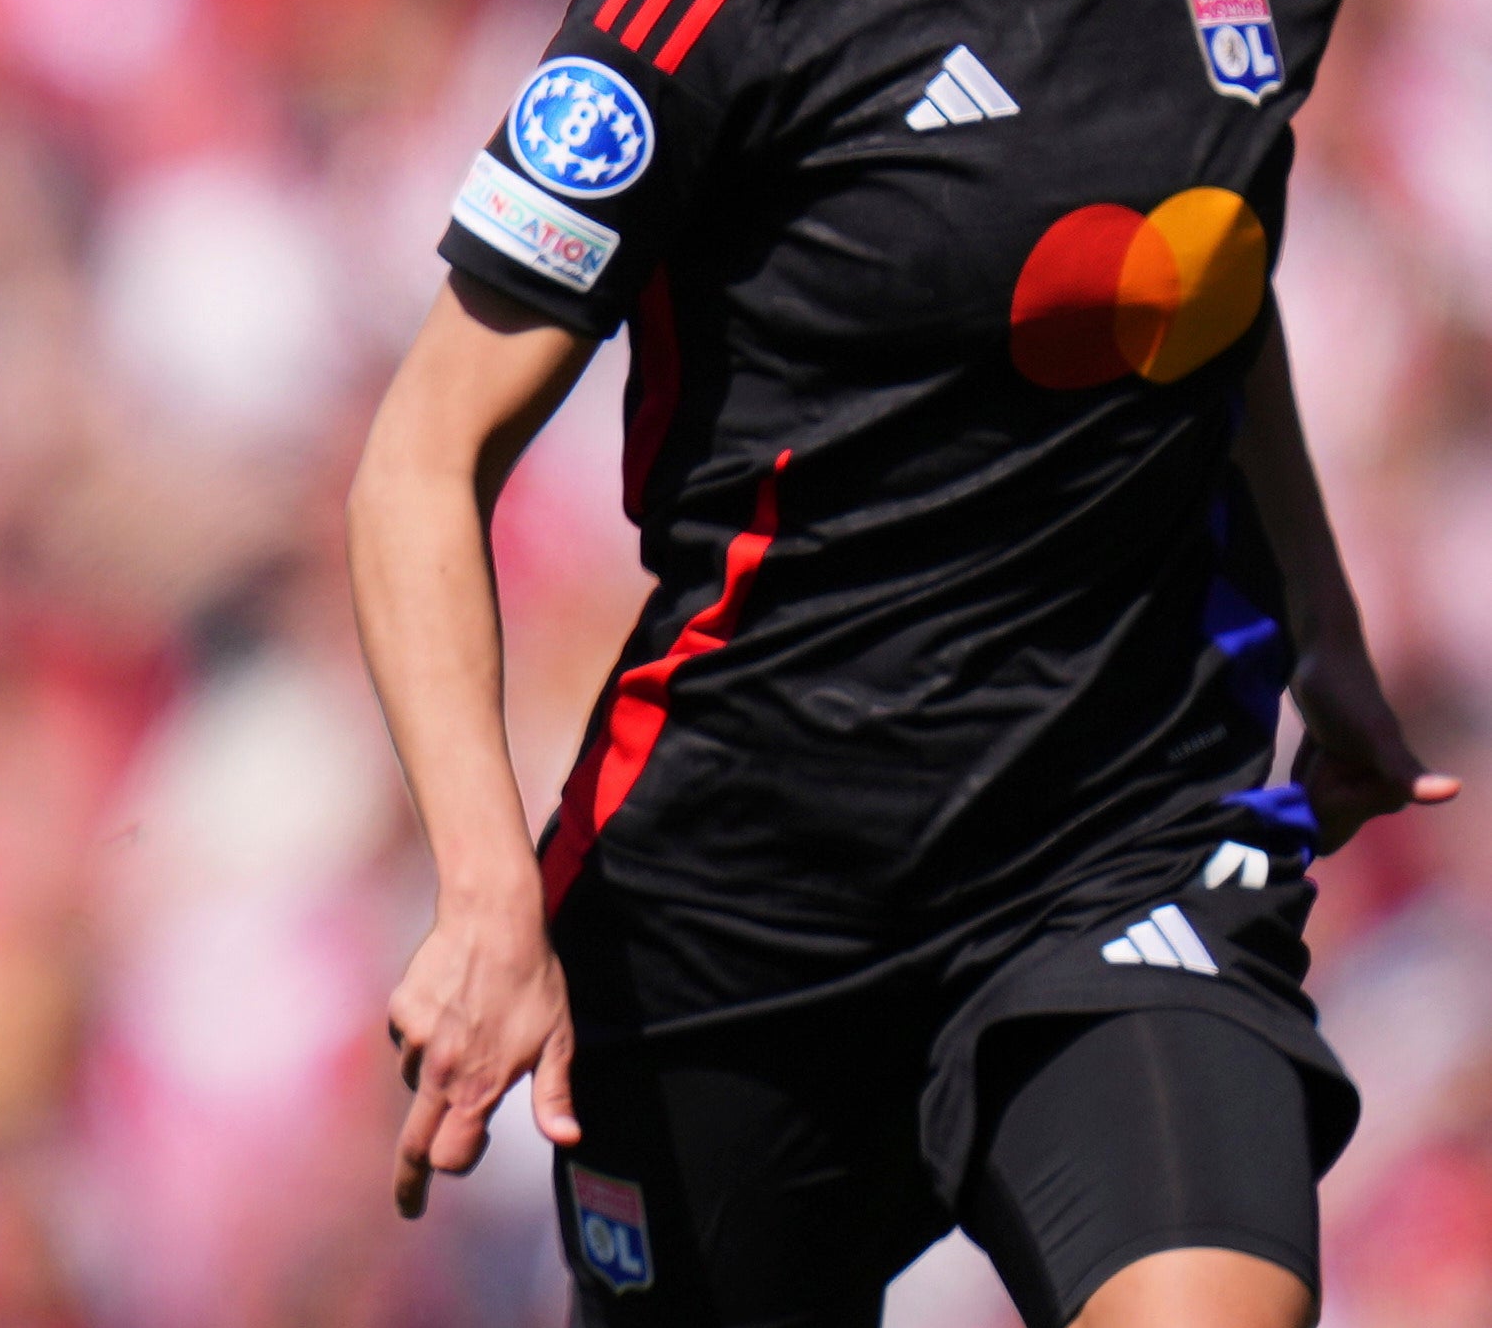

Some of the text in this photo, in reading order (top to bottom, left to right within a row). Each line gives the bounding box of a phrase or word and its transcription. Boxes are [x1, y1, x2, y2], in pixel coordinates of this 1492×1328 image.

[1211, 25, 1276, 78] OL
[560, 99, 600, 146] 8
[585, 1218, 641, 1273] OL
